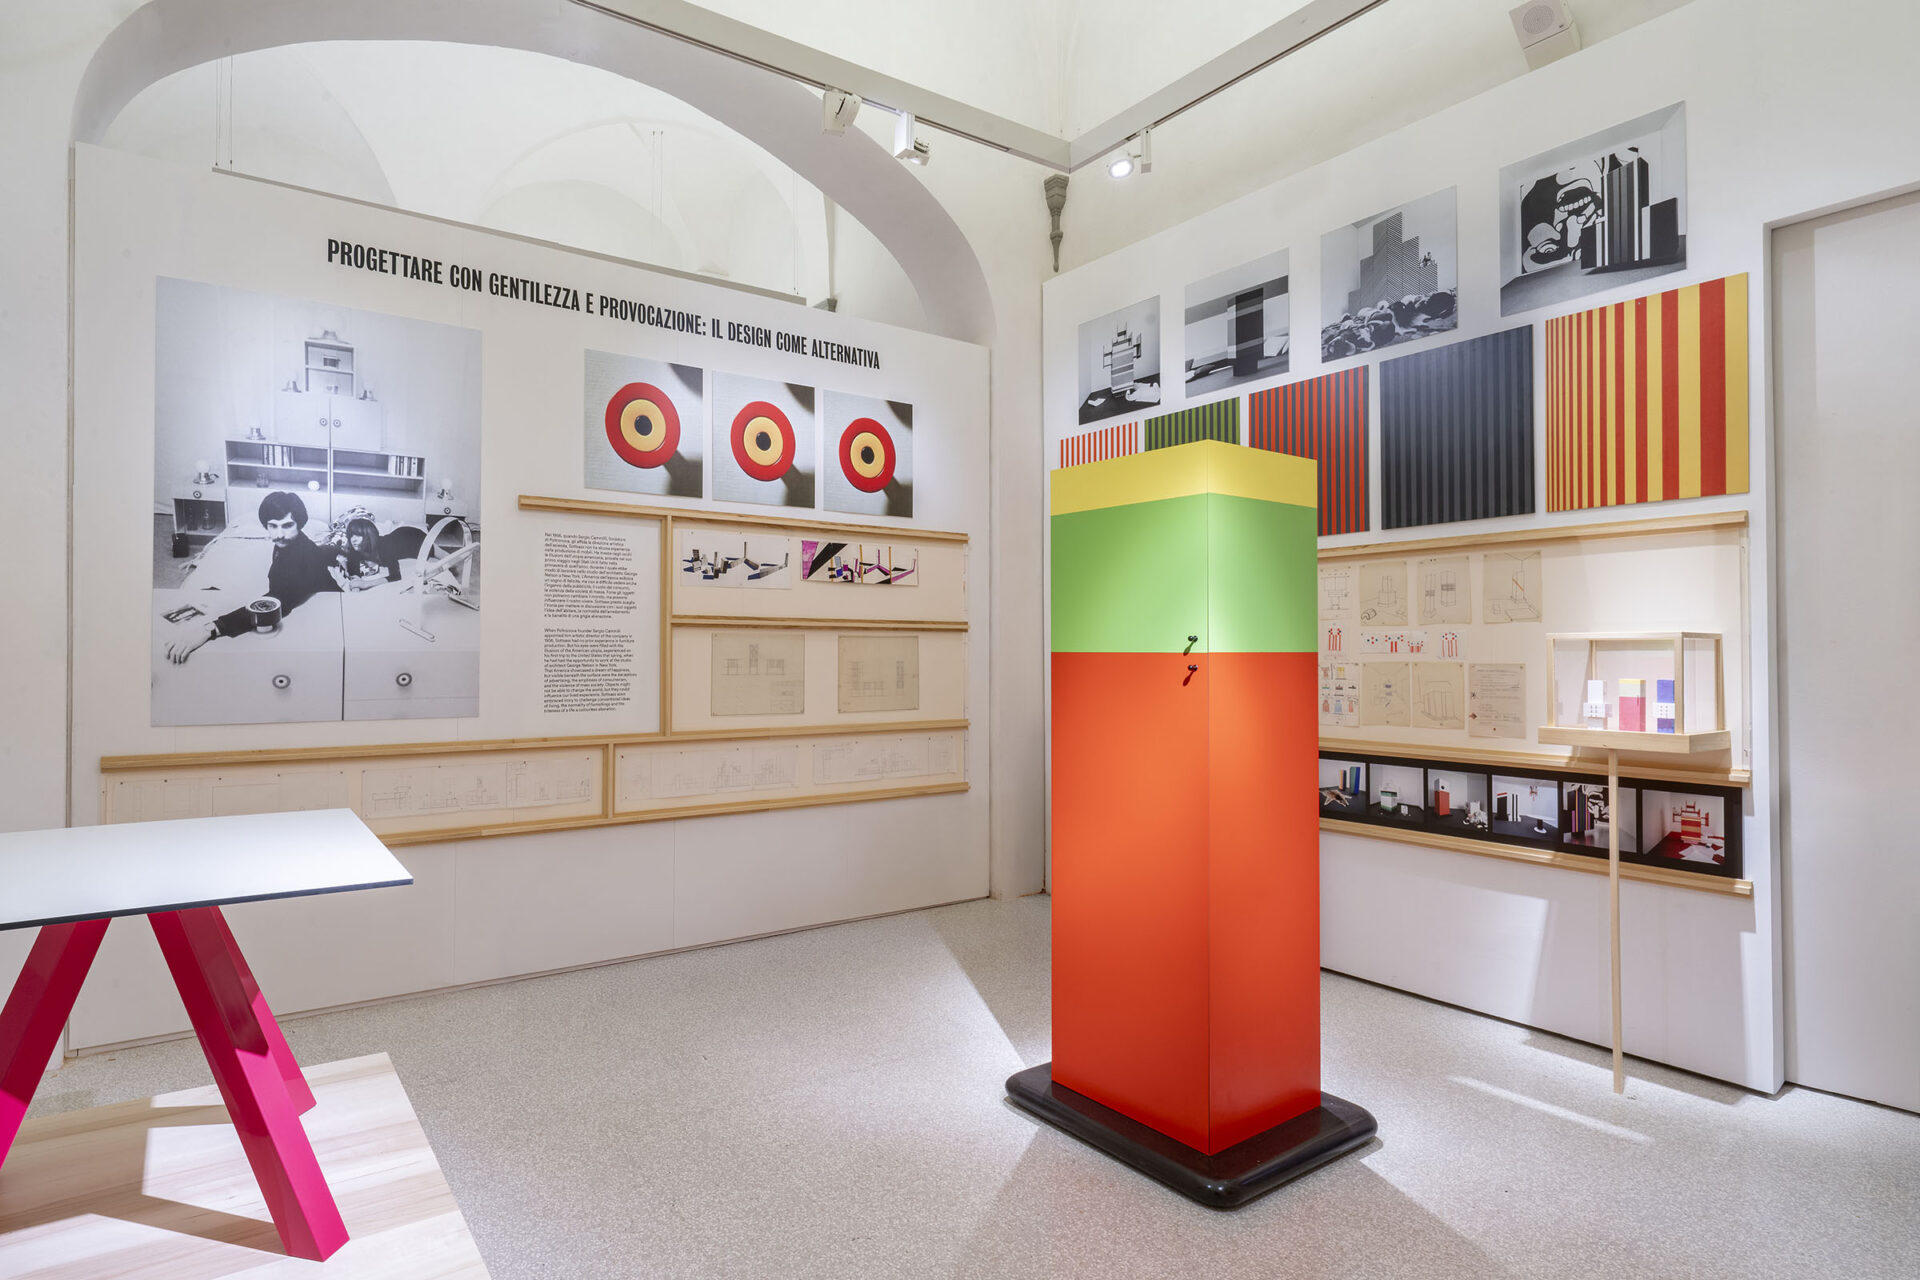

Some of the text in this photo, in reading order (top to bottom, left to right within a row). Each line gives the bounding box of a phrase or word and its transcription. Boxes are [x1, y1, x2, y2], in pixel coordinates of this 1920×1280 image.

[327, 238, 880, 370] PROGETTARE CON GENTILEZZA E PROVOCAZIONE: IL DESIGN COME ALTERNATIVA
